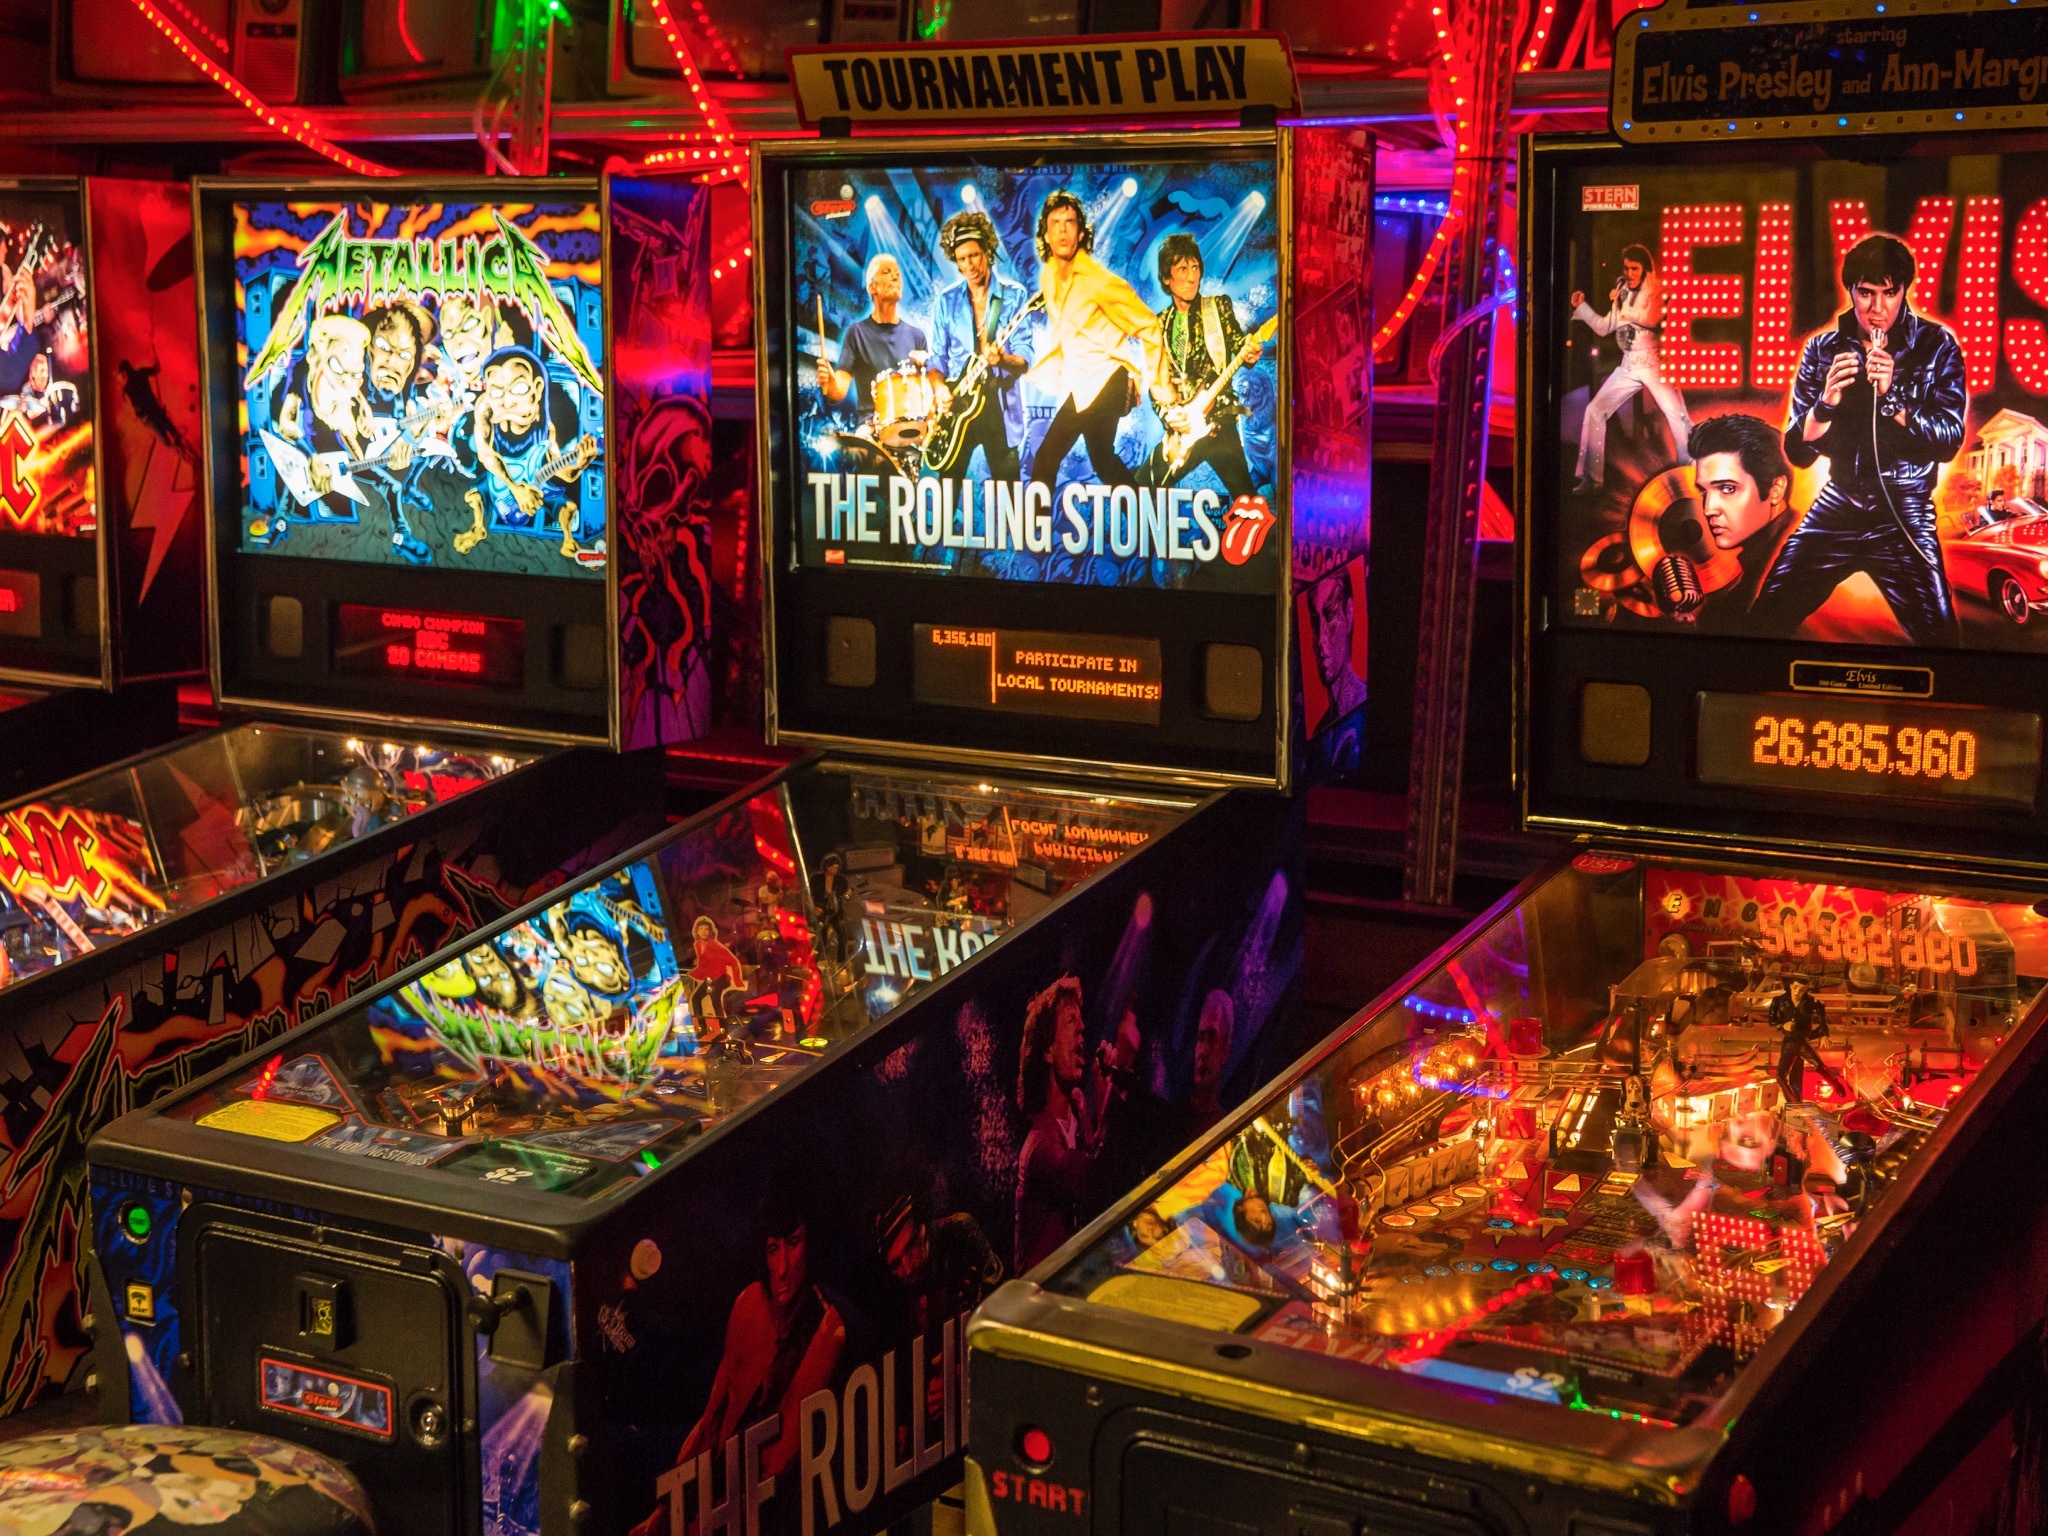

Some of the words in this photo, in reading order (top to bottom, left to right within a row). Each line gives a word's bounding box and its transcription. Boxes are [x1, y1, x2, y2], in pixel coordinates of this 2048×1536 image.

[1836, 26, 1907, 47] starring
[822, 50, 1123, 112] TOURNAMENT
[1135, 45, 1247, 104] PLAY
[1642, 60, 1708, 105] Elvis
[1719, 54, 1832, 111] Presley
[1842, 73, 1871, 95] and
[1584, 187, 1637, 203] STERN
[244, 208, 604, 398] METALLICA
[807, 471, 881, 543] THE
[889, 475, 1053, 554] ROLLING
[1062, 482, 1220, 562] STONES
[1015, 650, 1114, 671] PARTICIPATE
[1119, 658, 1138, 673] IN
[1846, 668, 1877, 682] Elvis
[996, 673, 1045, 690] LOCAL
[1049, 677, 1160, 700] TOURNAMENTS!
[1754, 716, 1977, 781] 26,385,960
[1578, 859, 1619, 871] USA
[313, 1136, 338, 1149] THE
[383, 1148, 434, 1166] STONES
[800, 1309, 971, 1536] ROLLI
[992, 1470, 1086, 1516] START
